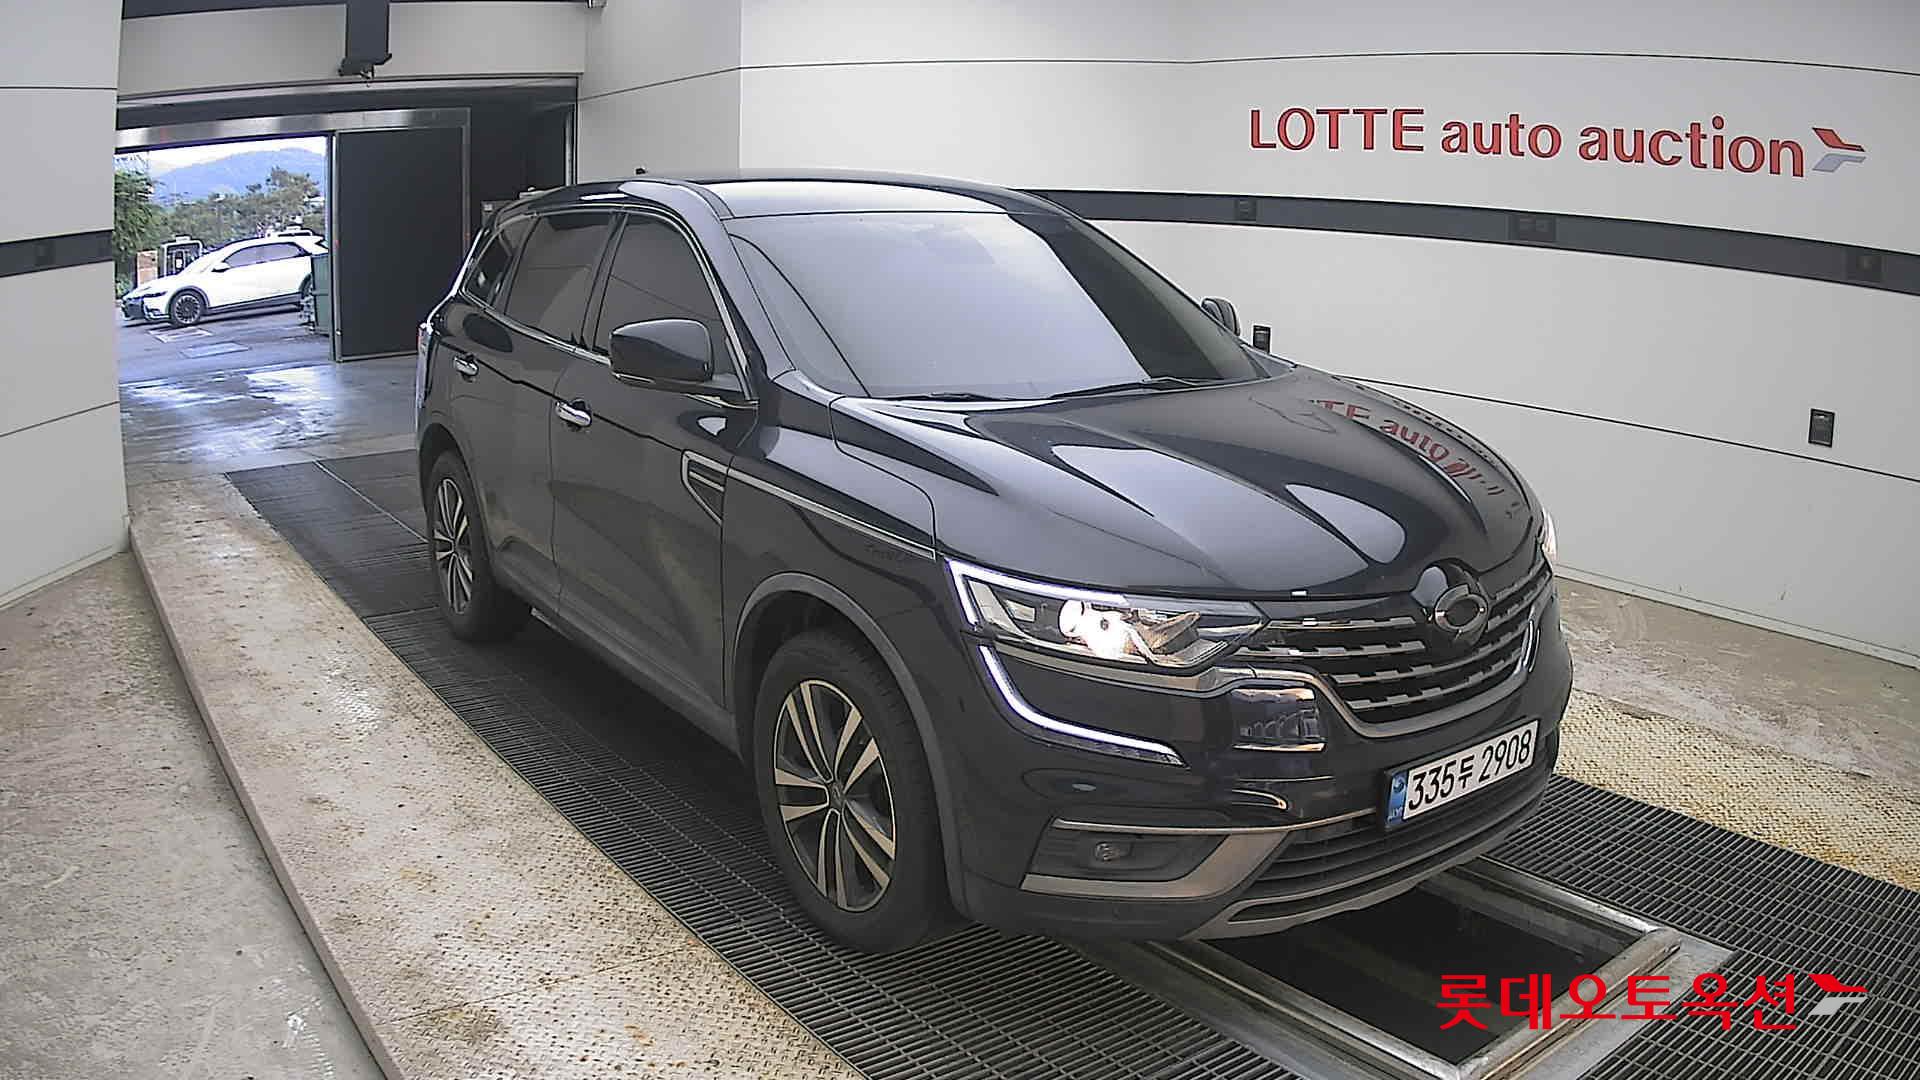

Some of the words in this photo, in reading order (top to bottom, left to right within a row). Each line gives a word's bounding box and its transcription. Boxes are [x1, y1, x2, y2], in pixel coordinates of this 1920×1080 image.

[1249, 107, 1425, 152] LOTTE
[1440, 112, 1562, 159] auto
[1578, 115, 1806, 178] auction
[1407, 753, 1476, 812] 335두
[1478, 728, 1533, 783] 2908
